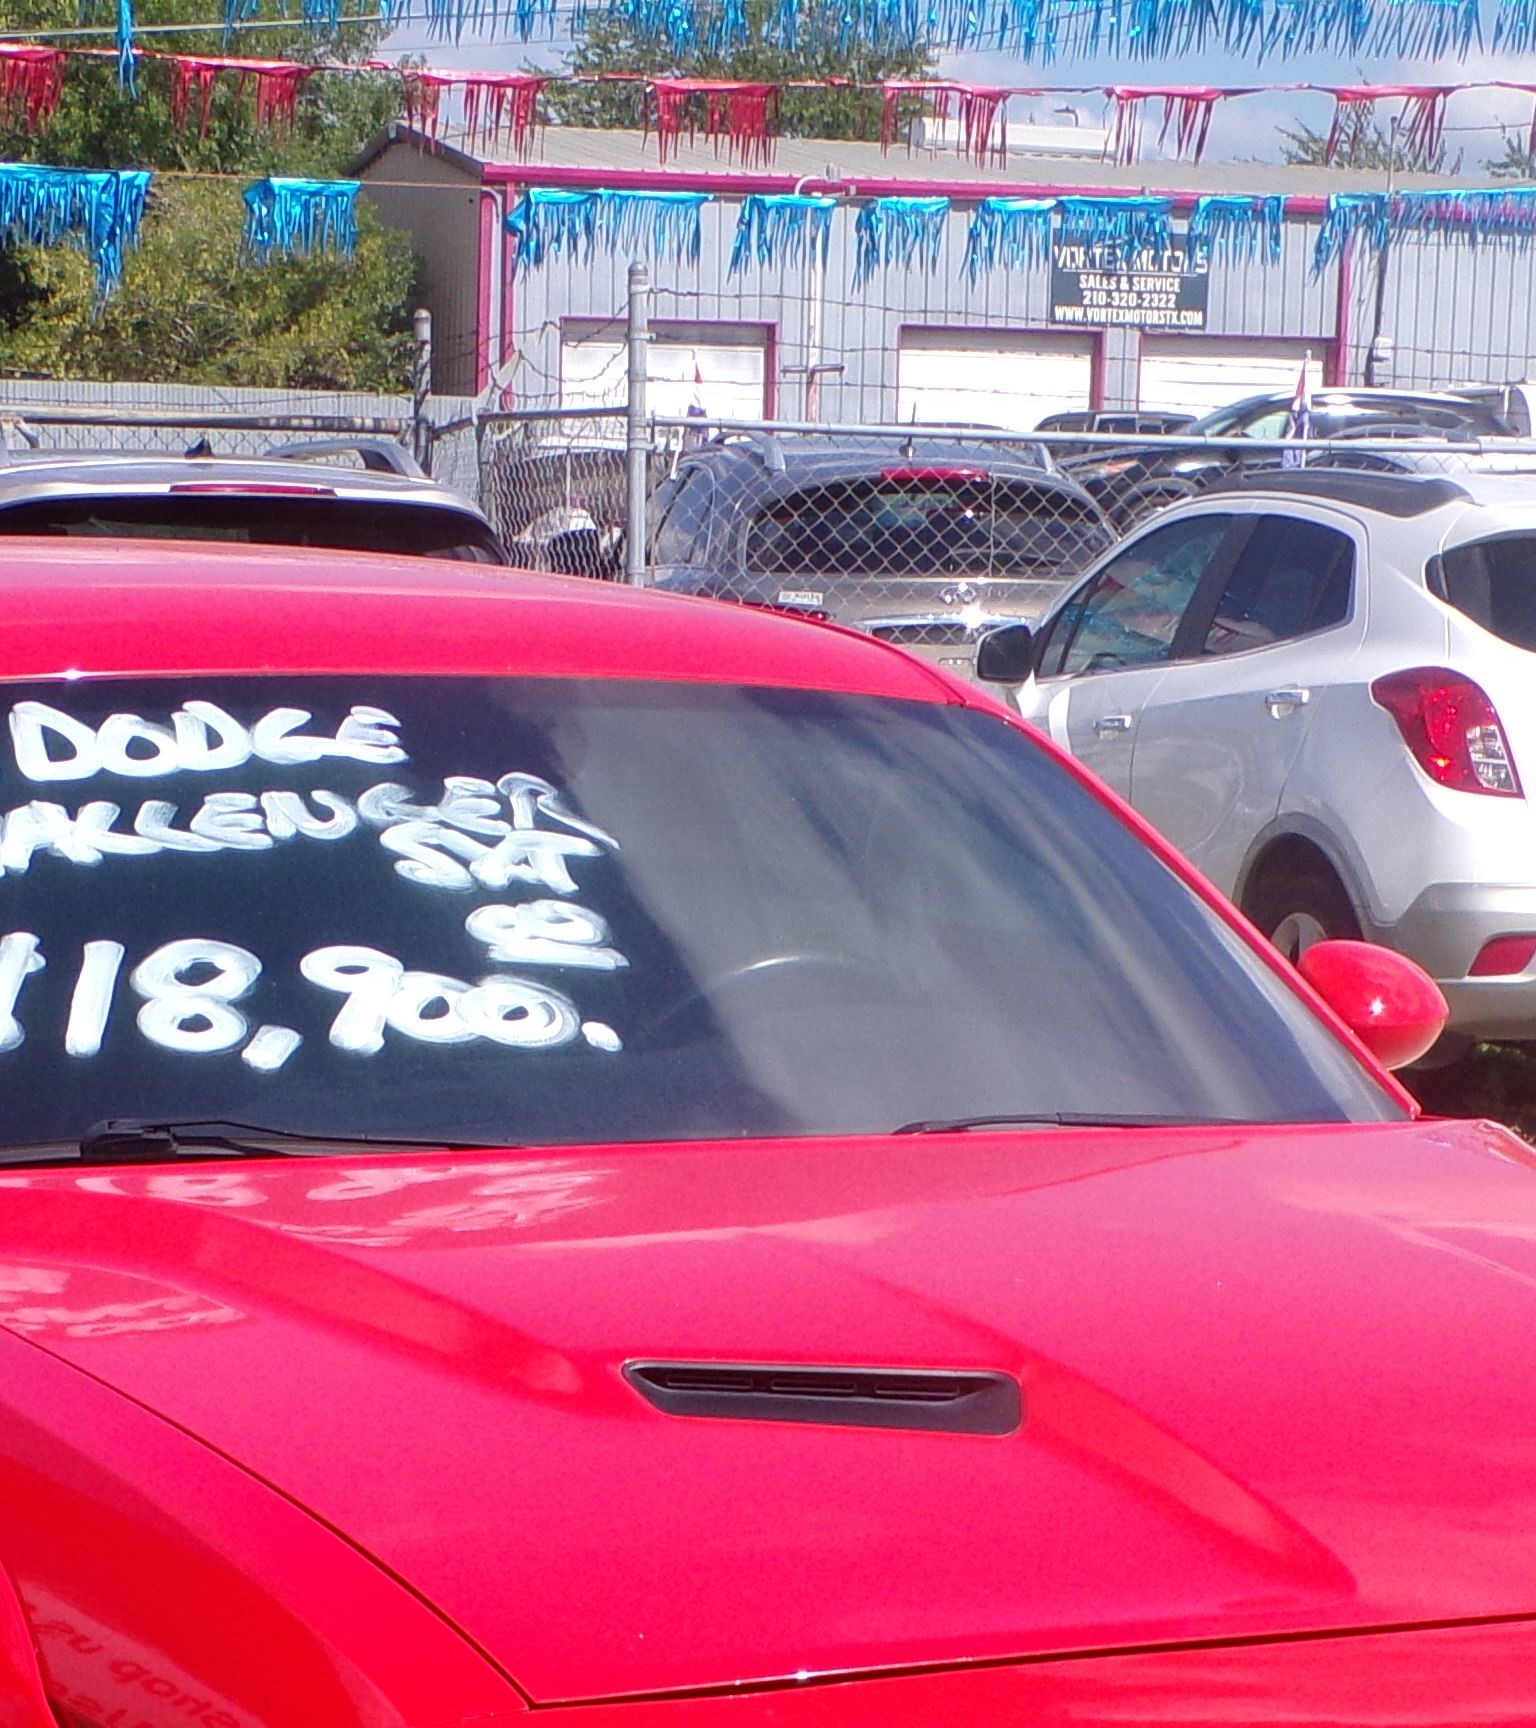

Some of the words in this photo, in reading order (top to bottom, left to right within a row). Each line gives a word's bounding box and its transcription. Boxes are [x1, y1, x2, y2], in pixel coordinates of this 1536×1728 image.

[1079, 274, 1117, 290] SALES
[1119, 275, 1129, 291] &
[1132, 276, 1181, 293] SERVICE
[1082, 290, 1177, 308] 210-320-2322
[1054, 304, 1204, 326] WWW.VORTEXMOTORSTX.COM
[9, 700, 410, 782] DODGE
